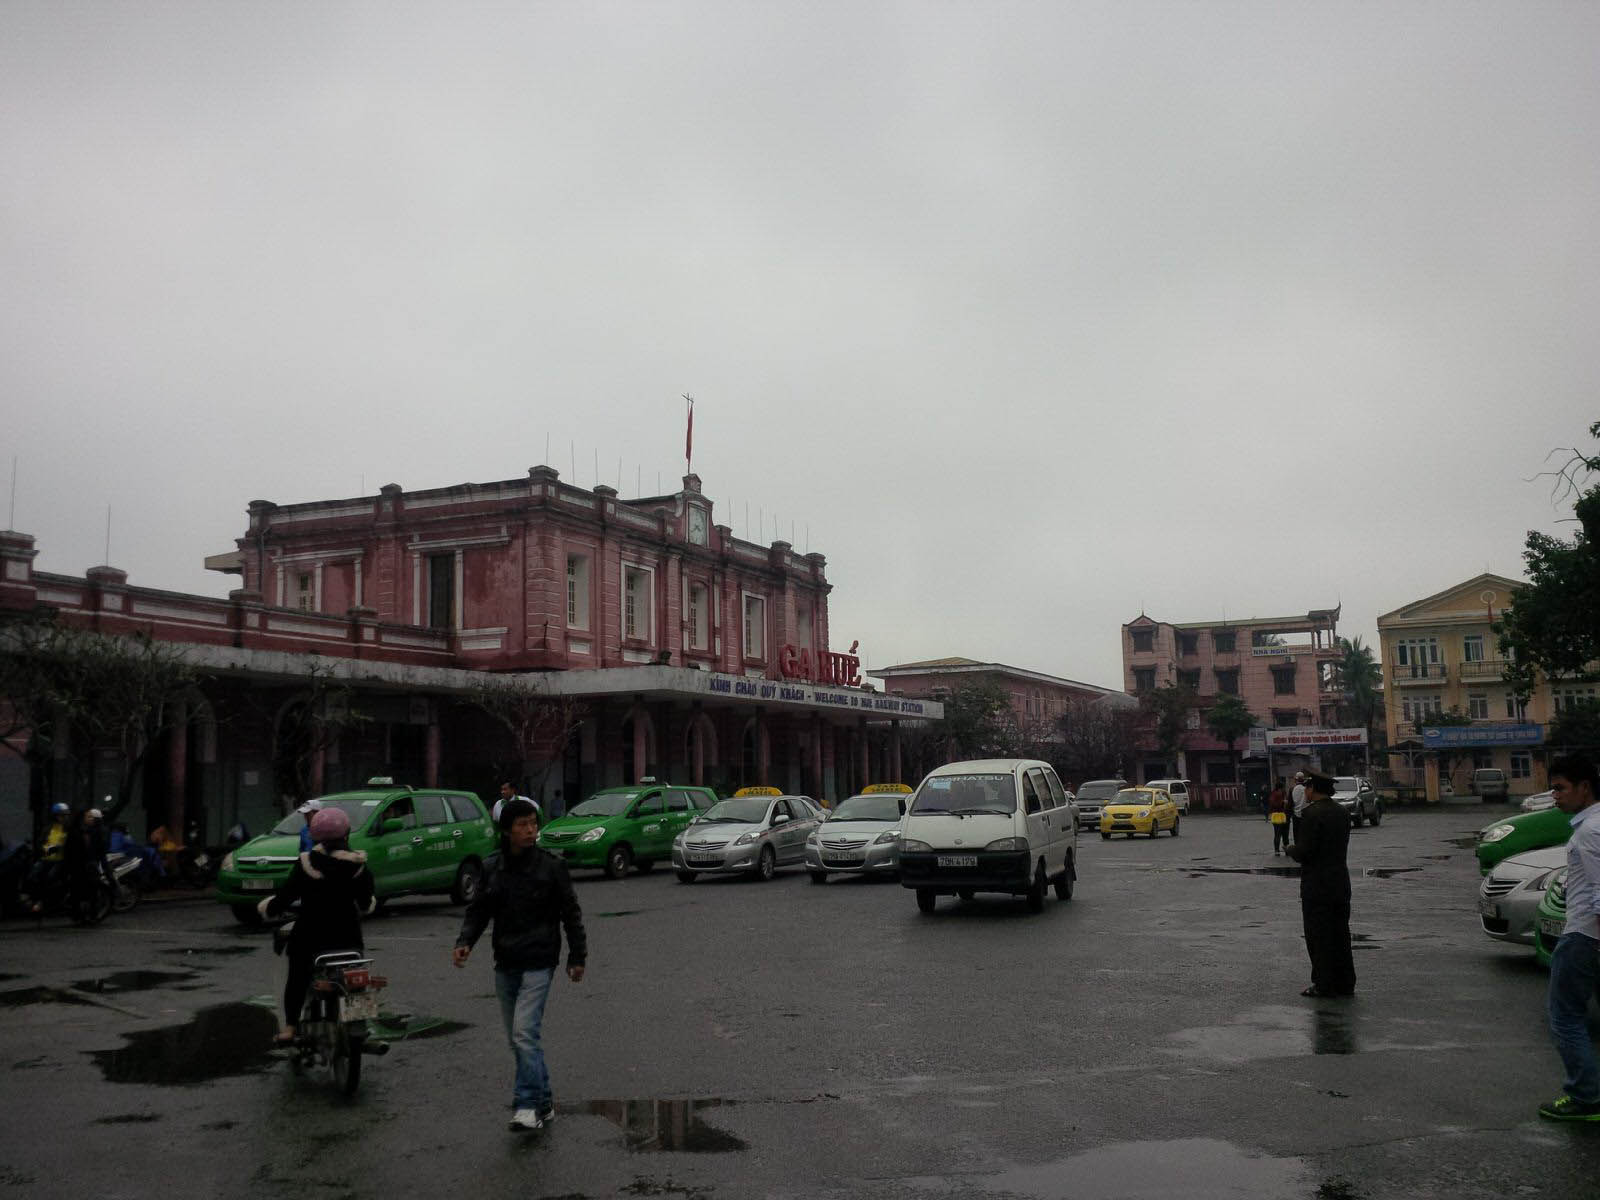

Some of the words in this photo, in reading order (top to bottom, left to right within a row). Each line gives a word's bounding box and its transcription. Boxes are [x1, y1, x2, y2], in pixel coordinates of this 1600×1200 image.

[780, 644, 813, 682] GA
[709, 676, 731, 693] KÍNH
[761, 684, 776, 699] QUÝ
[780, 686, 805, 701] KHÁCH
[814, 691, 848, 705] WELCOME
[901, 701, 923, 714] STATION
